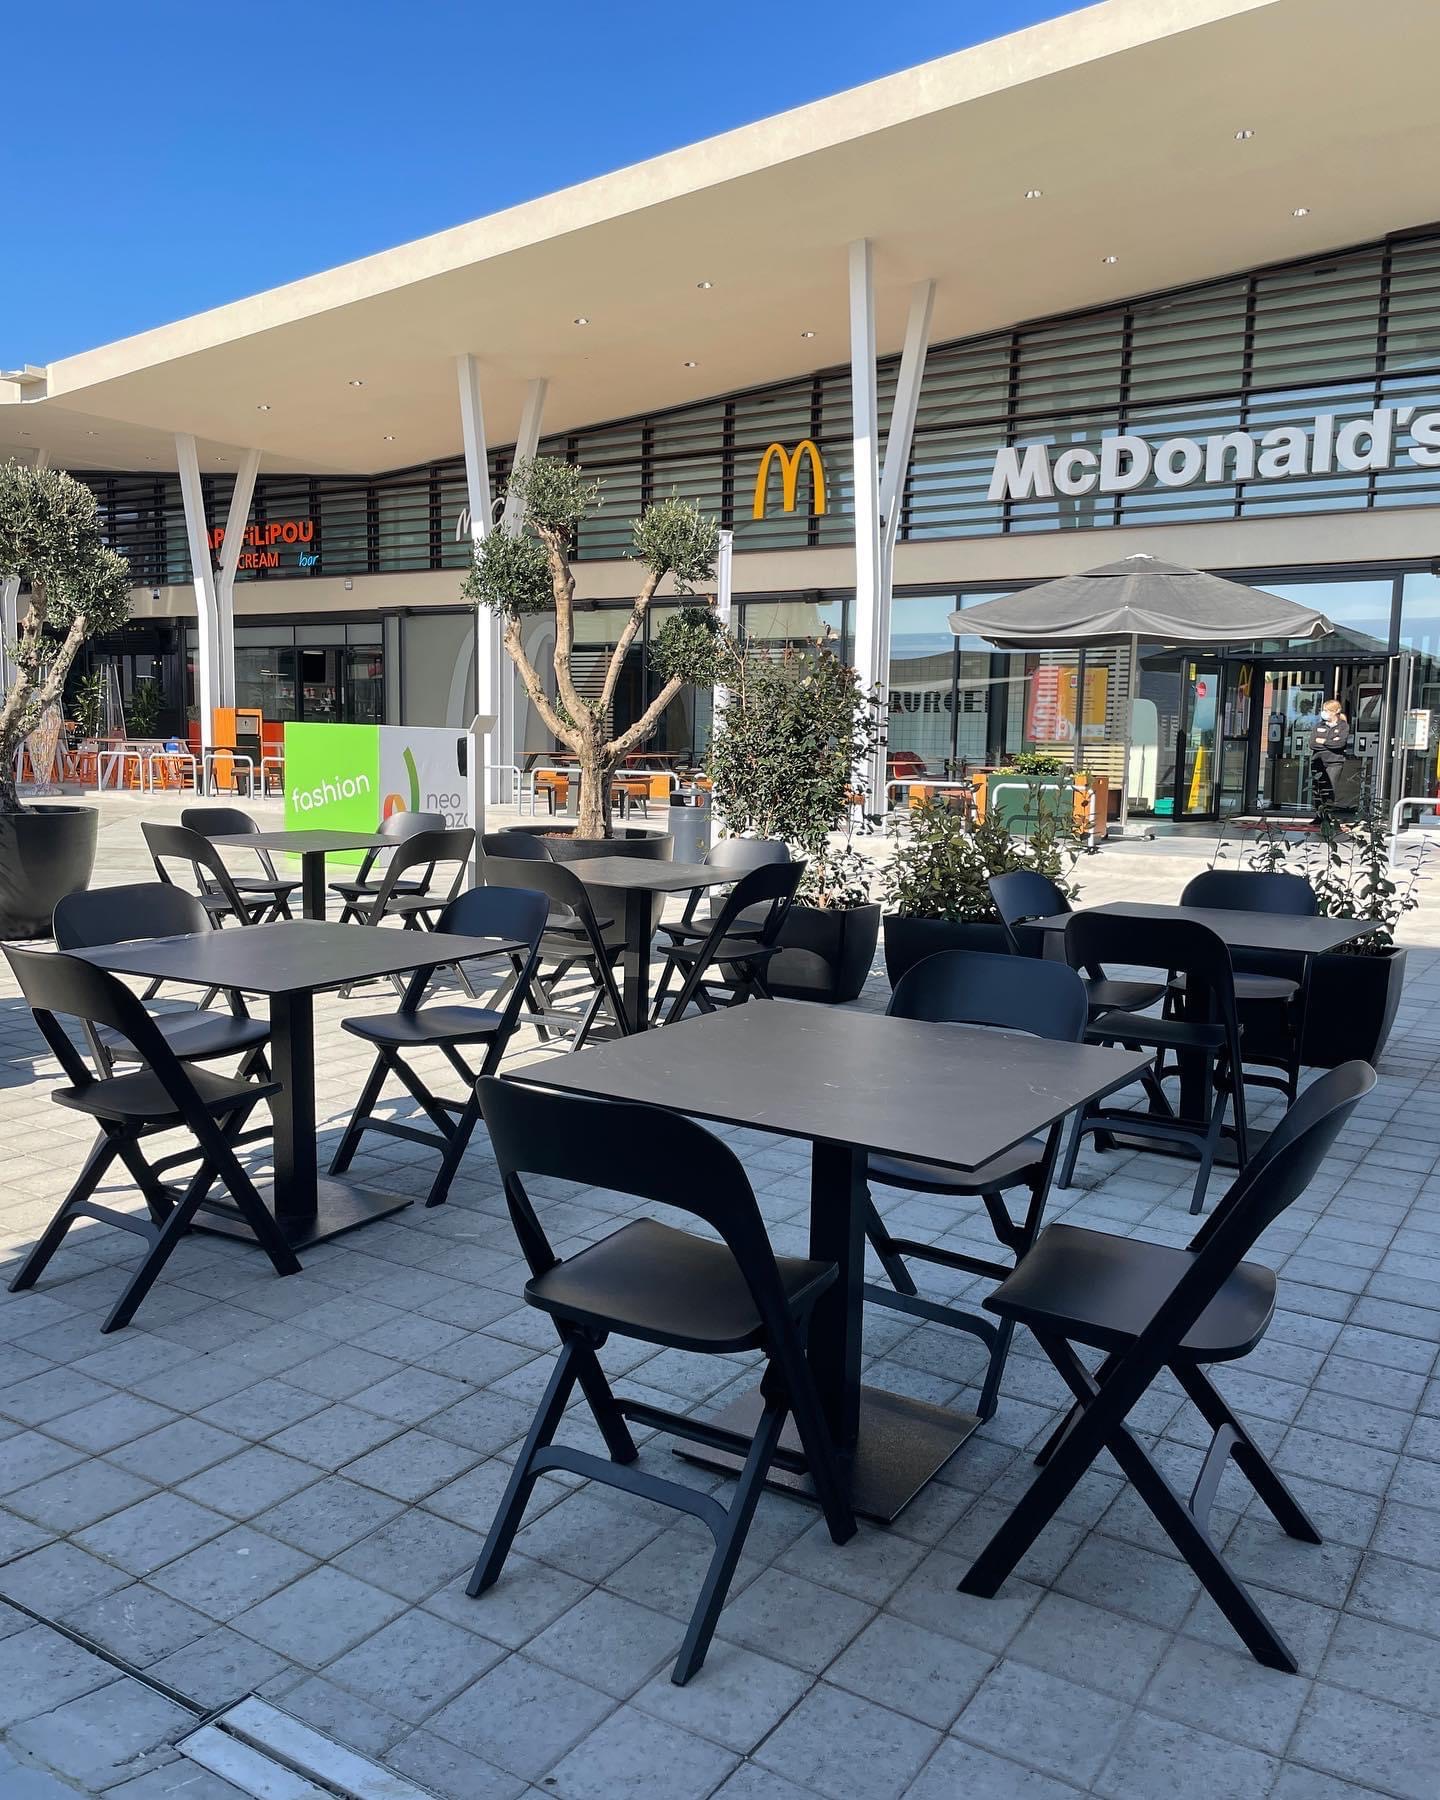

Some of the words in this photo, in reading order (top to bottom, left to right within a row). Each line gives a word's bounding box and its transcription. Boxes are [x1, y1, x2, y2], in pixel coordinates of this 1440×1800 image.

[988, 407, 1440, 500] McDonald's
[238, 552, 279, 568] CREAM
[298, 552, 319, 567] bar
[888, 691, 988, 713] BURGE
[292, 774, 371, 813] fashion
[426, 793, 461, 809] neo
